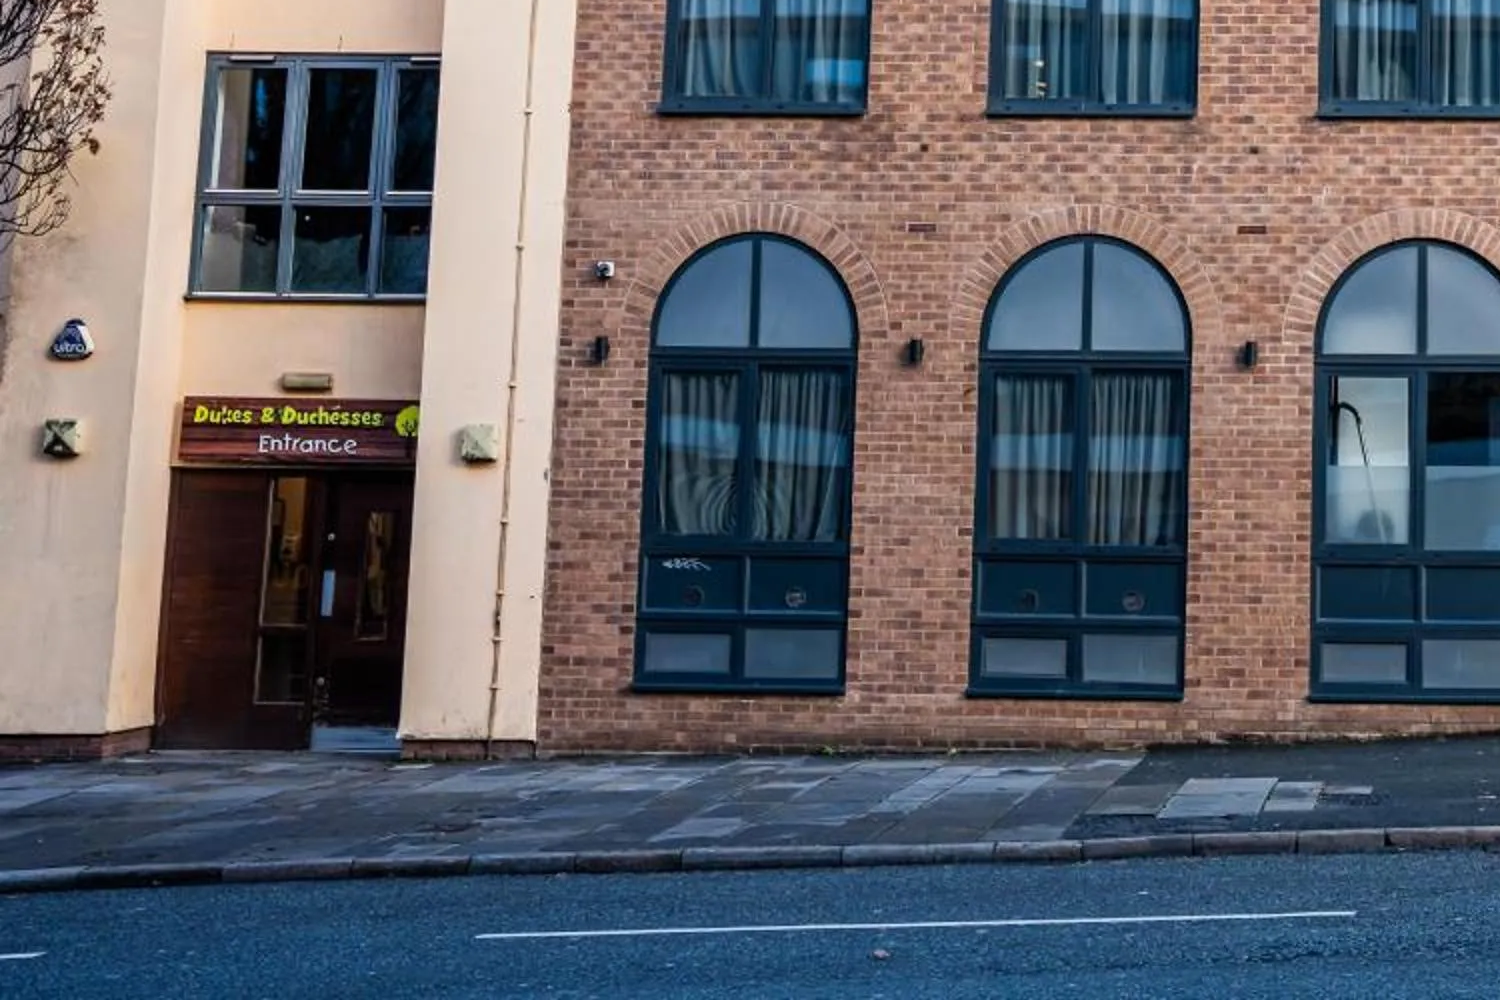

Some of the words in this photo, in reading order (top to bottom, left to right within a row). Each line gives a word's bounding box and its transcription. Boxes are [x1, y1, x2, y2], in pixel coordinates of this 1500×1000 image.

[193, 405, 252, 425] Dukes
[260, 405, 274, 423] &
[281, 405, 383, 426] Duchesses
[259, 433, 357, 454] Entrance
